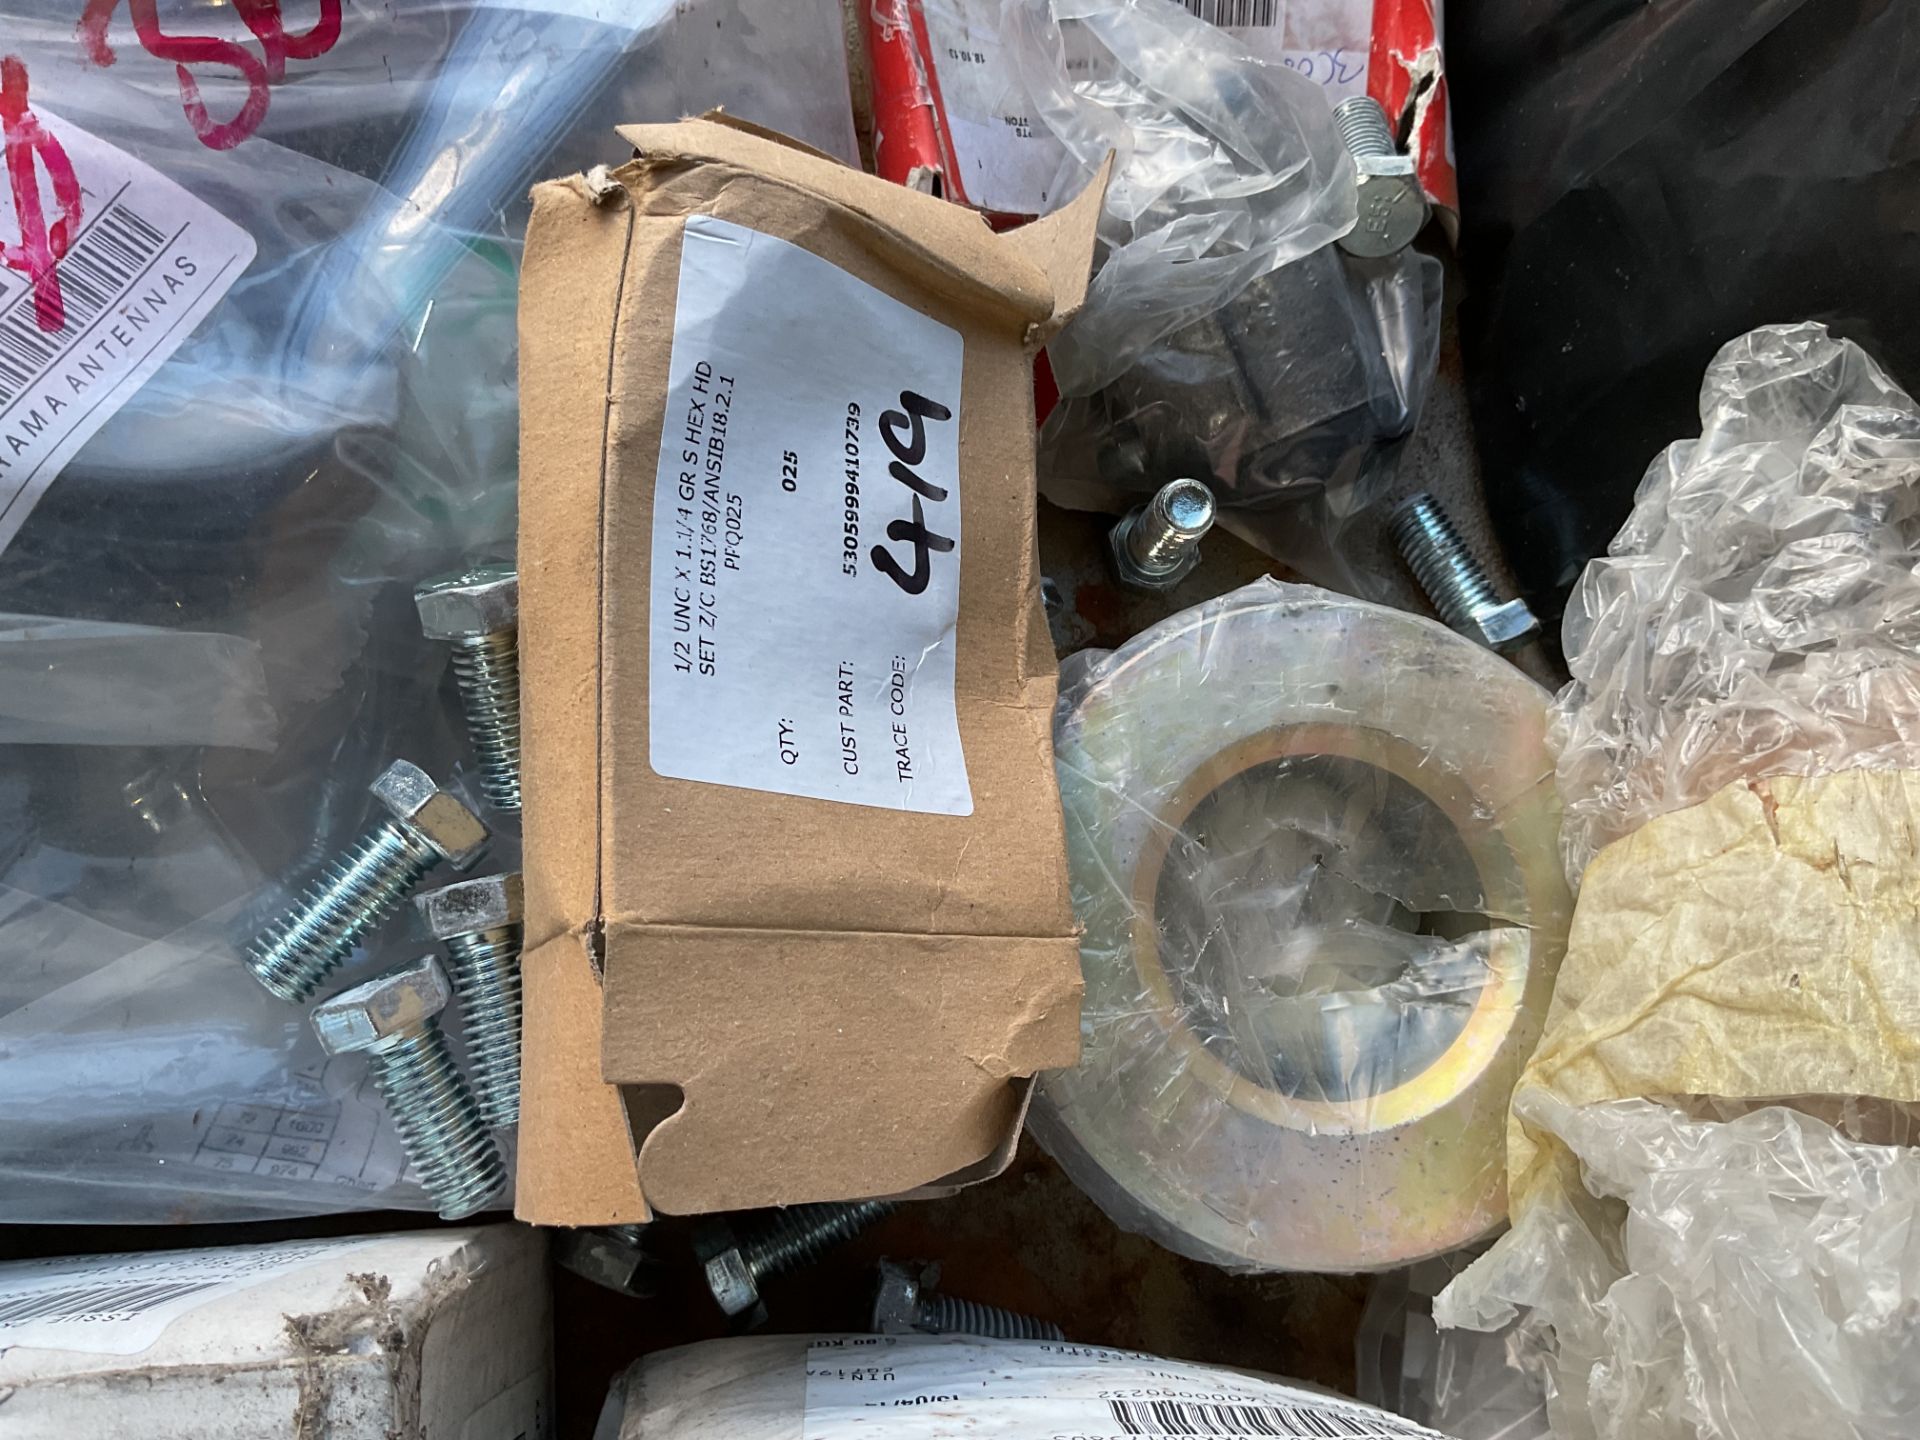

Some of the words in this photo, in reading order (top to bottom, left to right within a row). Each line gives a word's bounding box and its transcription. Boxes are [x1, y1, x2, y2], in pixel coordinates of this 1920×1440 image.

[65, 254, 198, 394] ANTENNAS
[692, 360, 713, 395] HD
[684, 398, 707, 445] HEX
[678, 471, 697, 501] GR
[699, 375, 736, 587] BS1768/ANSIB18.2.1
[781, 449, 799, 493] 025
[843, 401, 861, 578] 5305999410739
[674, 566, 692, 582] X
[673, 587, 691, 633] UNC
[698, 591, 718, 631] Z/C
[674, 641, 694, 674] 1/2
[698, 634, 716, 677] SET
[838, 660, 854, 718] PART:
[890, 655, 906, 716] CODE:
[778, 718, 799, 766] QTY:
[841, 722, 859, 776] CUST
[892, 721, 914, 783] TRACE
